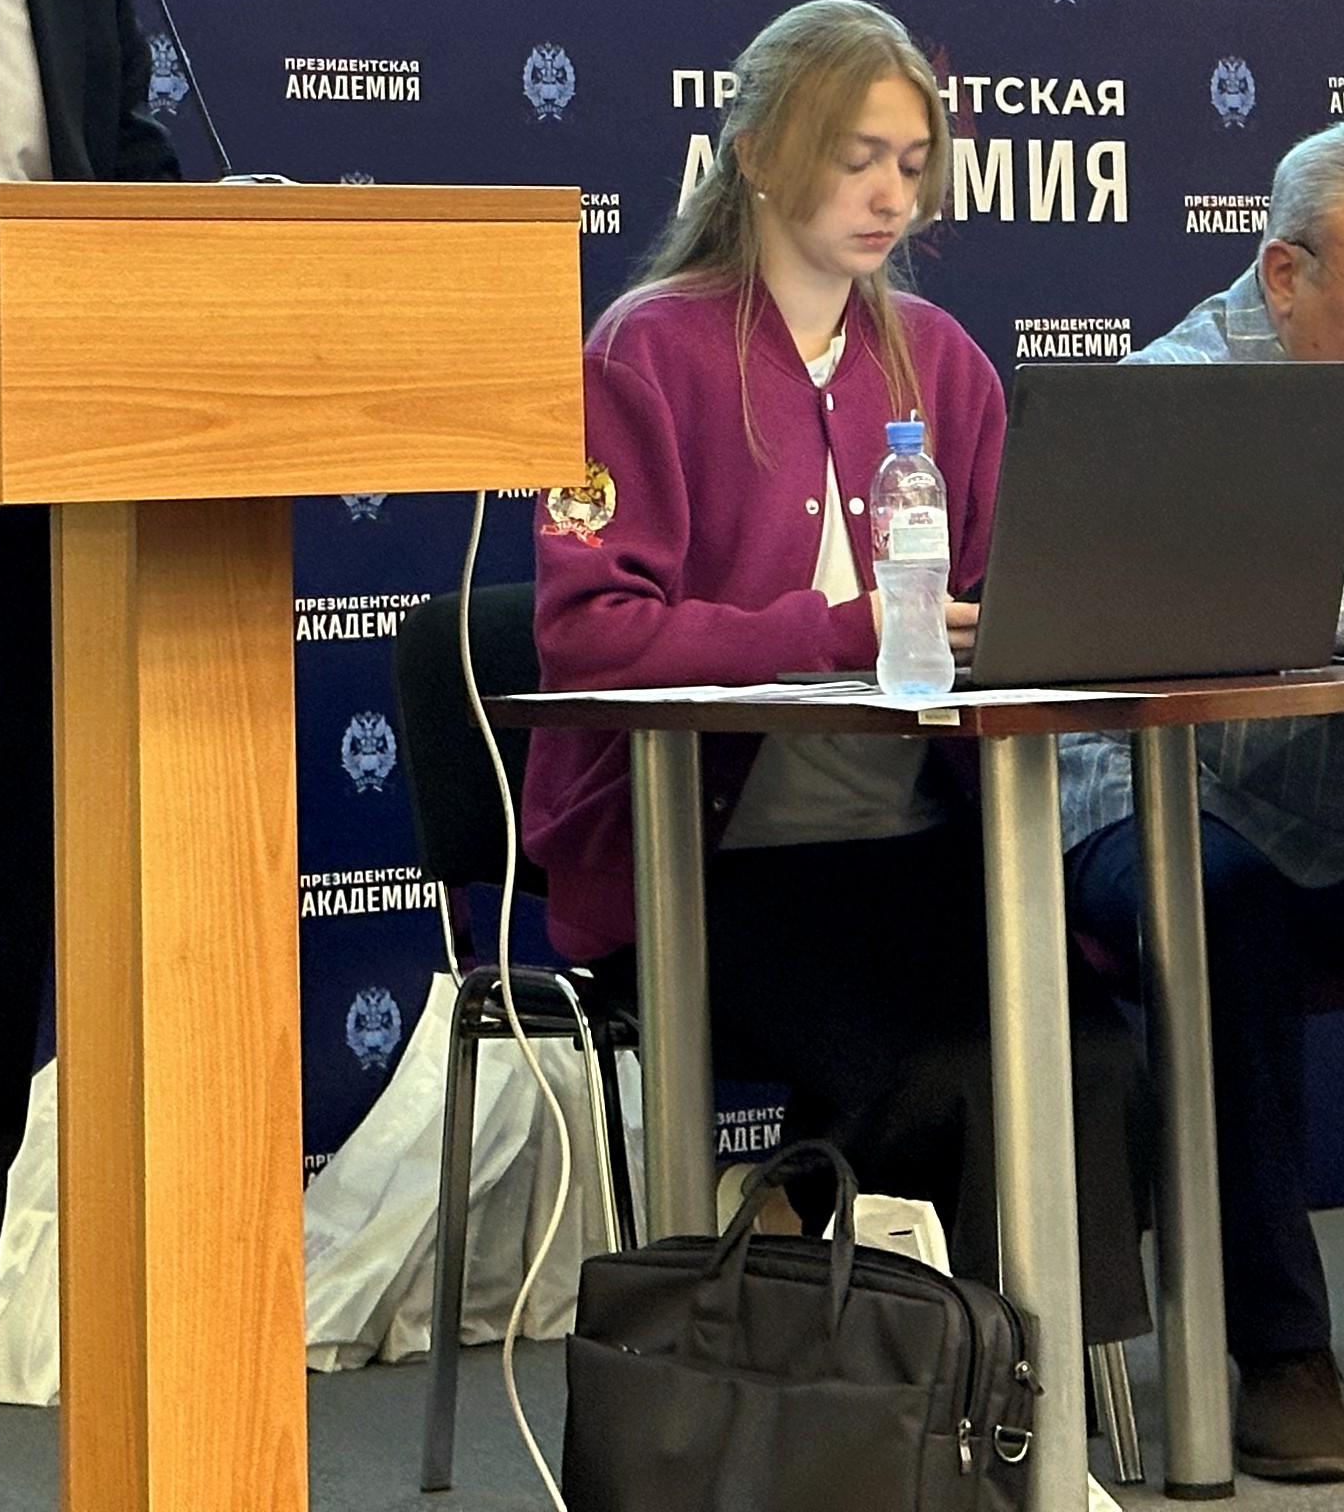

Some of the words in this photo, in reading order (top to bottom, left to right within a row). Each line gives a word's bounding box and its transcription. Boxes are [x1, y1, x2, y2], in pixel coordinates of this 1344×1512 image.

[285, 58, 419, 72] ПРЕЗИДЕНТСКАЯ
[286, 74, 419, 100] АКАДЕМИЯ
[672, 70, 1125, 116] ПРНТСКАЯ
[677, 134, 1128, 223] АМИЯ
[1185, 195, 1270, 207] ПРЕЗИДЕНТС
[1186, 210, 1268, 233] АКАДЕМ
[1015, 318, 1131, 330] ПРЕЗИДЕНТСКАЯ
[1017, 333, 1131, 358] АКАДЕМИЯ
[296, 610, 405, 641] АКАДЕМ
[301, 882, 437, 918] АКАДЕМИЯ
[717, 1106, 785, 1125] ЗИДЕНТС
[717, 1123, 781, 1155] АДЕМ
